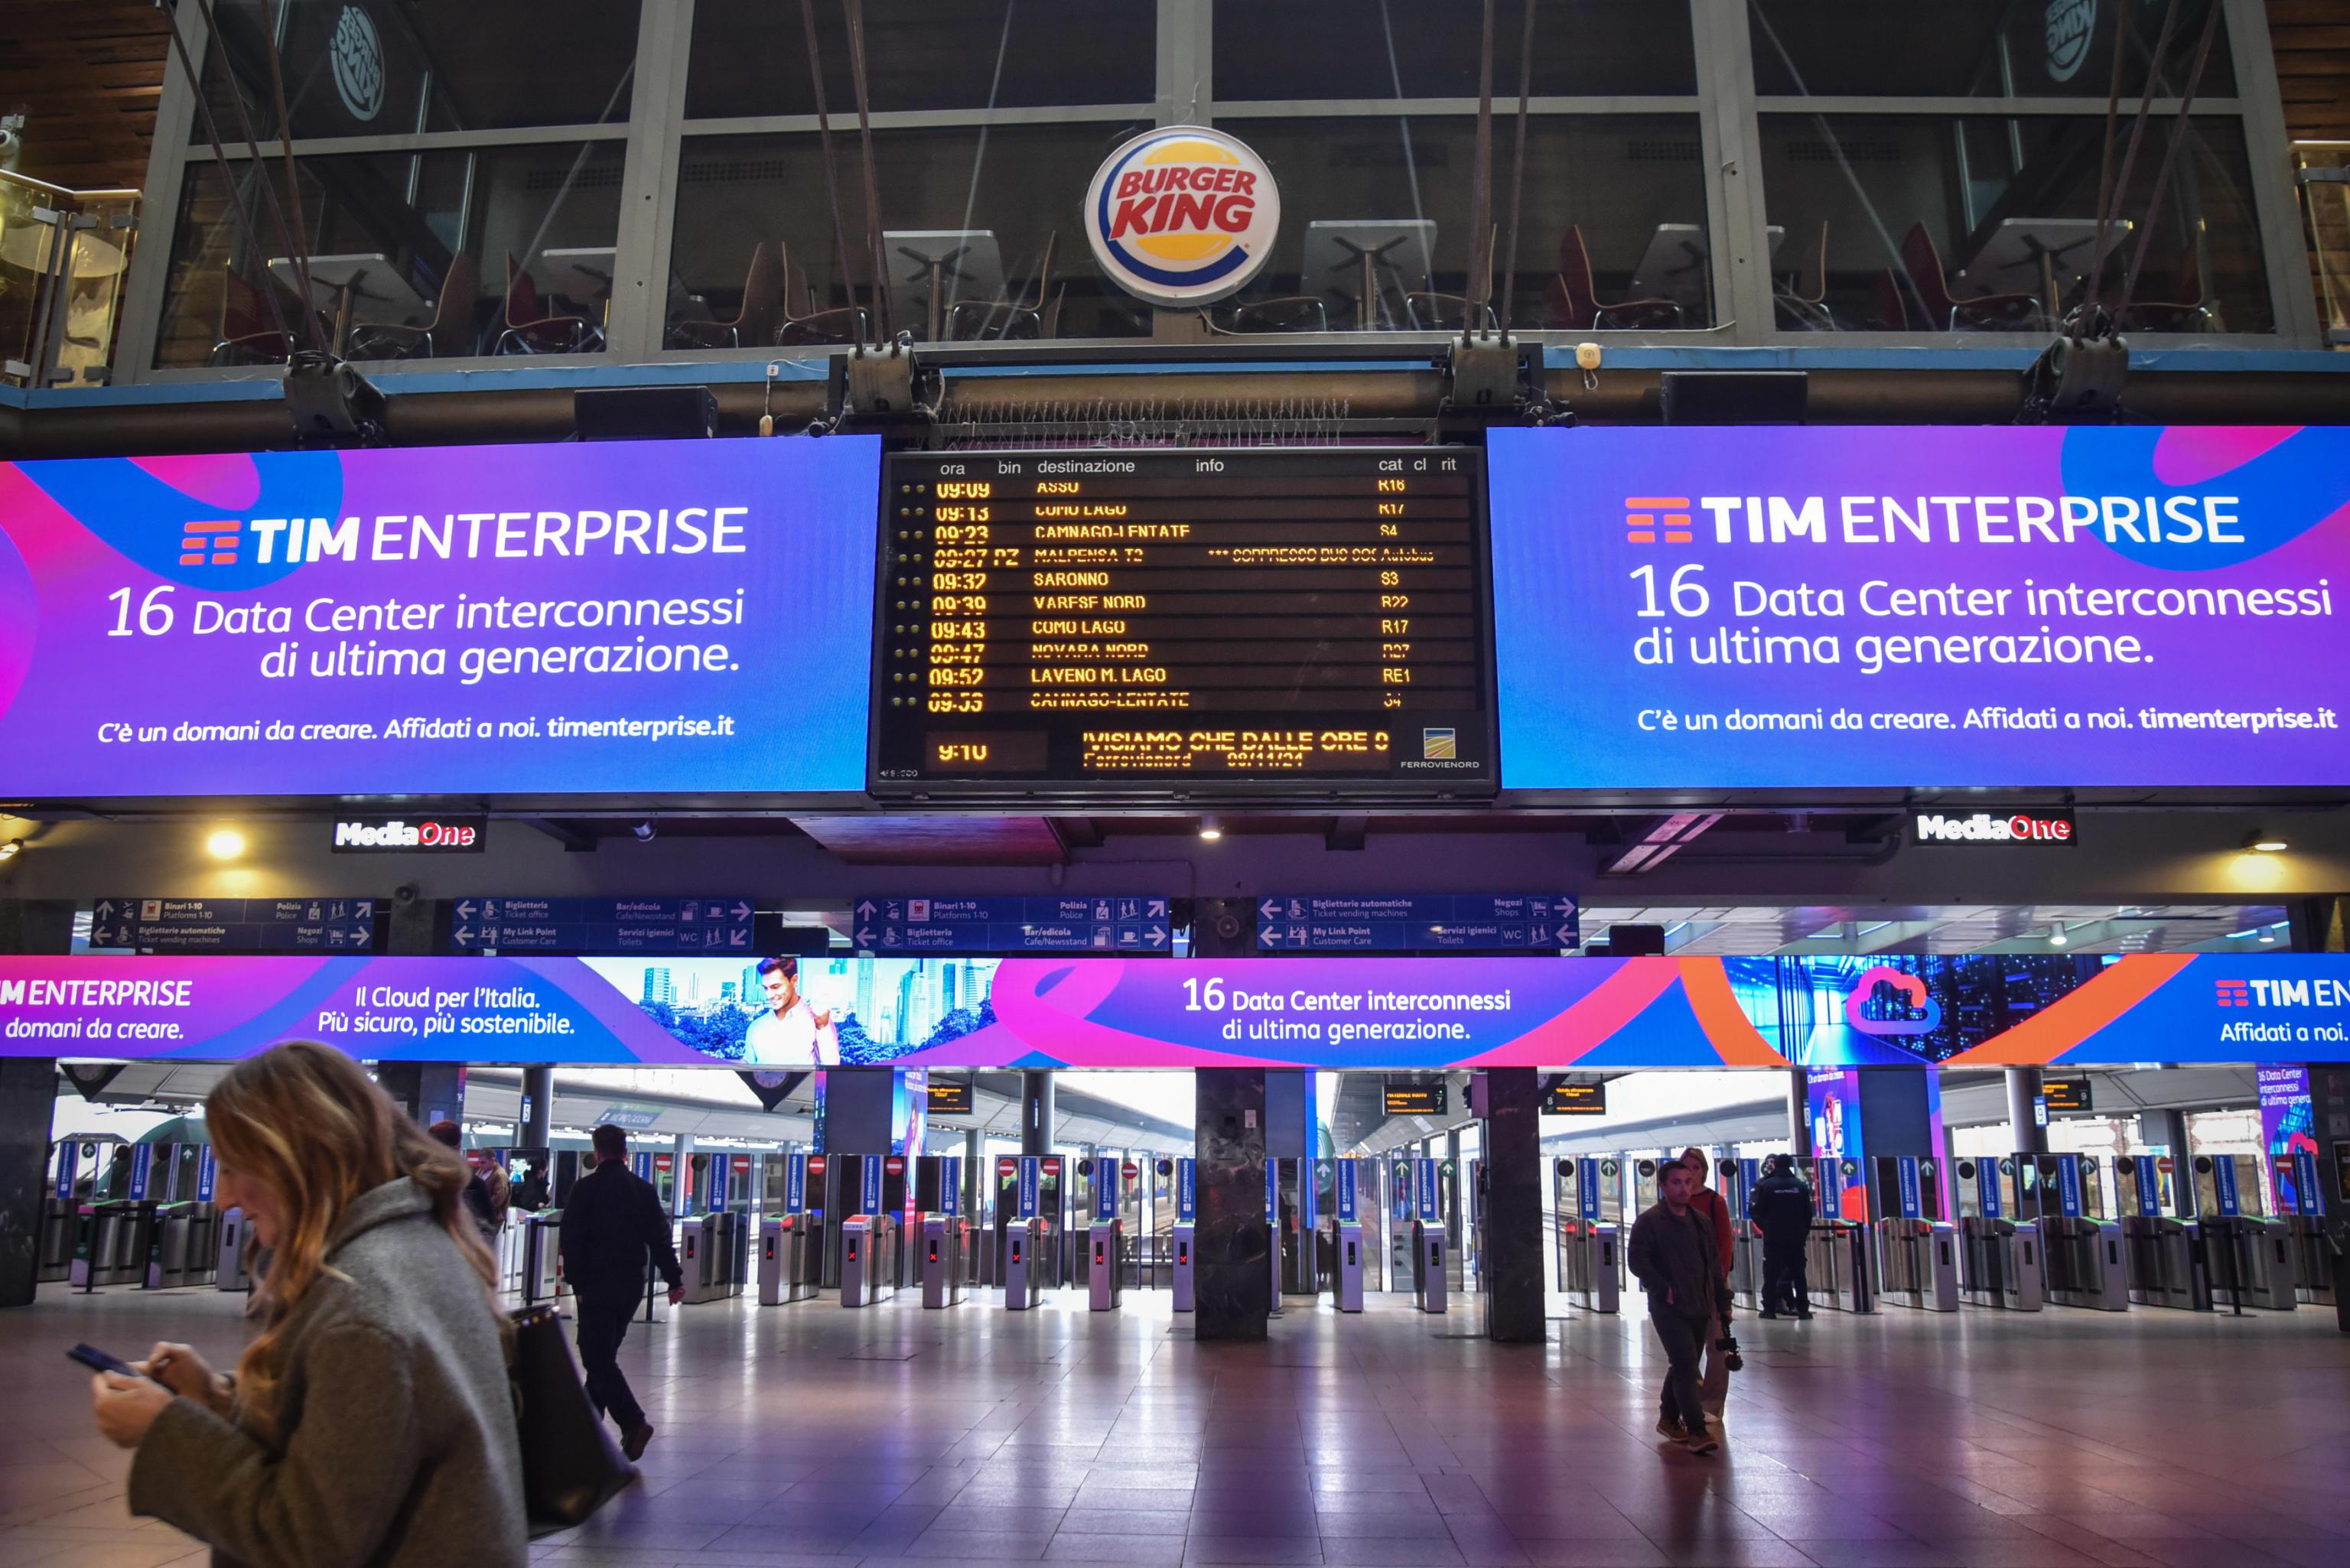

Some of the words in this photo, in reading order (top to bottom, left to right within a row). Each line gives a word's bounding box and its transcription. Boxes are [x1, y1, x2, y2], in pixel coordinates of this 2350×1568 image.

[1117, 168, 1256, 199] BURGER
[1110, 194, 1255, 239] KING
[940, 464, 965, 475] ora
[998, 460, 1021, 474] bin
[1037, 459, 1135, 473] destinazione
[1196, 458, 1225, 472] info
[1378, 458, 1403, 471] cat
[1414, 457, 1427, 471] cl
[1441, 457, 1457, 470] rit
[936, 483, 990, 499] 09:09
[936, 507, 989, 522] 09:13
[1701, 496, 1827, 543] TIM
[1841, 496, 2245, 543] ENTERPRISE
[250, 516, 360, 564] TIM
[371, 506, 748, 561] ENTERPRISE
[933, 573, 987, 590] 09:32
[1033, 572, 1109, 587] SARONNO
[1381, 571, 1399, 586] S3
[1629, 563, 1710, 617] 16
[1733, 581, 1845, 616] Data
[1859, 580, 2013, 616] Center
[2024, 578, 2332, 616] interconnessi
[108, 585, 175, 636] 16
[193, 600, 292, 635] Data
[304, 597, 445, 633] Center
[456, 587, 744, 629] interconnessi
[1102, 595, 1146, 609] NORD
[931, 621, 985, 639] 09:43
[1032, 620, 1077, 634] COMO
[1081, 620, 1125, 634] LAGO
[1382, 620, 1408, 634] R17
[260, 641, 299, 678] di
[311, 639, 446, 677] ultima
[459, 635, 739, 685] generazione.
[1633, 626, 1674, 665] di
[1690, 626, 1841, 665] ultima
[1855, 625, 2154, 675] generazione.
[929, 668, 984, 685] 09:52
[1031, 668, 1097, 683] LAVENO
[1100, 668, 1118, 682] M.
[1121, 668, 1167, 682] LAGO
[1383, 668, 1410, 683] RE1
[138, 727, 168, 743] un
[172, 720, 261, 742] domani
[265, 720, 295, 740] da
[300, 724, 378, 740] creare.
[382, 717, 472, 739] Affidati
[477, 722, 493, 738] a
[498, 716, 541, 738] noi.
[546, 714, 734, 742] timenterprise.it
[1684, 714, 1718, 730] un
[1725, 708, 1823, 730] domani
[1830, 708, 1863, 730] da
[1870, 713, 1957, 730] creare.
[1963, 706, 2058, 730] Affidati
[2064, 712, 2081, 729] a
[2087, 707, 2134, 729] noi.
[2137, 707, 2339, 734] timenterprise.it
[1060, 901, 1087, 909] Polizia
[1495, 899, 1522, 908] Negozi
[1495, 908, 1518, 917] Shops
[934, 911, 970, 919] Platforms
[1060, 911, 1083, 919] Police
[1313, 928, 1327, 936] My
[1346, 927, 1370, 935] Point
[1353, 937, 1372, 945] Care
[1504, 931, 1522, 940] WC
[28, 980, 193, 1007] ENTERPRISE
[356, 986, 366, 1007] Il
[372, 986, 430, 1008] Cloud
[435, 992, 466, 1013] per
[1183, 977, 1225, 1011] 16
[1232, 991, 1284, 1011] Data
[1290, 990, 1362, 1011] Center
[1367, 989, 1511, 1011] interconnessi
[2250, 980, 2309, 1007] TIM
[5, 1017, 83, 1038] domani
[86, 1017, 112, 1039] da
[117, 1023, 184, 1039] creare.
[318, 1010, 349, 1033] Più
[353, 1010, 418, 1036] sicuro,
[424, 1009, 455, 1038] più
[461, 1013, 574, 1034] sostenibile.
[1222, 1018, 1242, 1039] di
[1249, 1018, 1320, 1039] ultima
[1327, 1017, 1470, 1046] generazione.
[2221, 1022, 2291, 1042] Affidati
[2296, 1027, 2309, 1041] a
[2314, 1023, 2348, 1041] noi.
